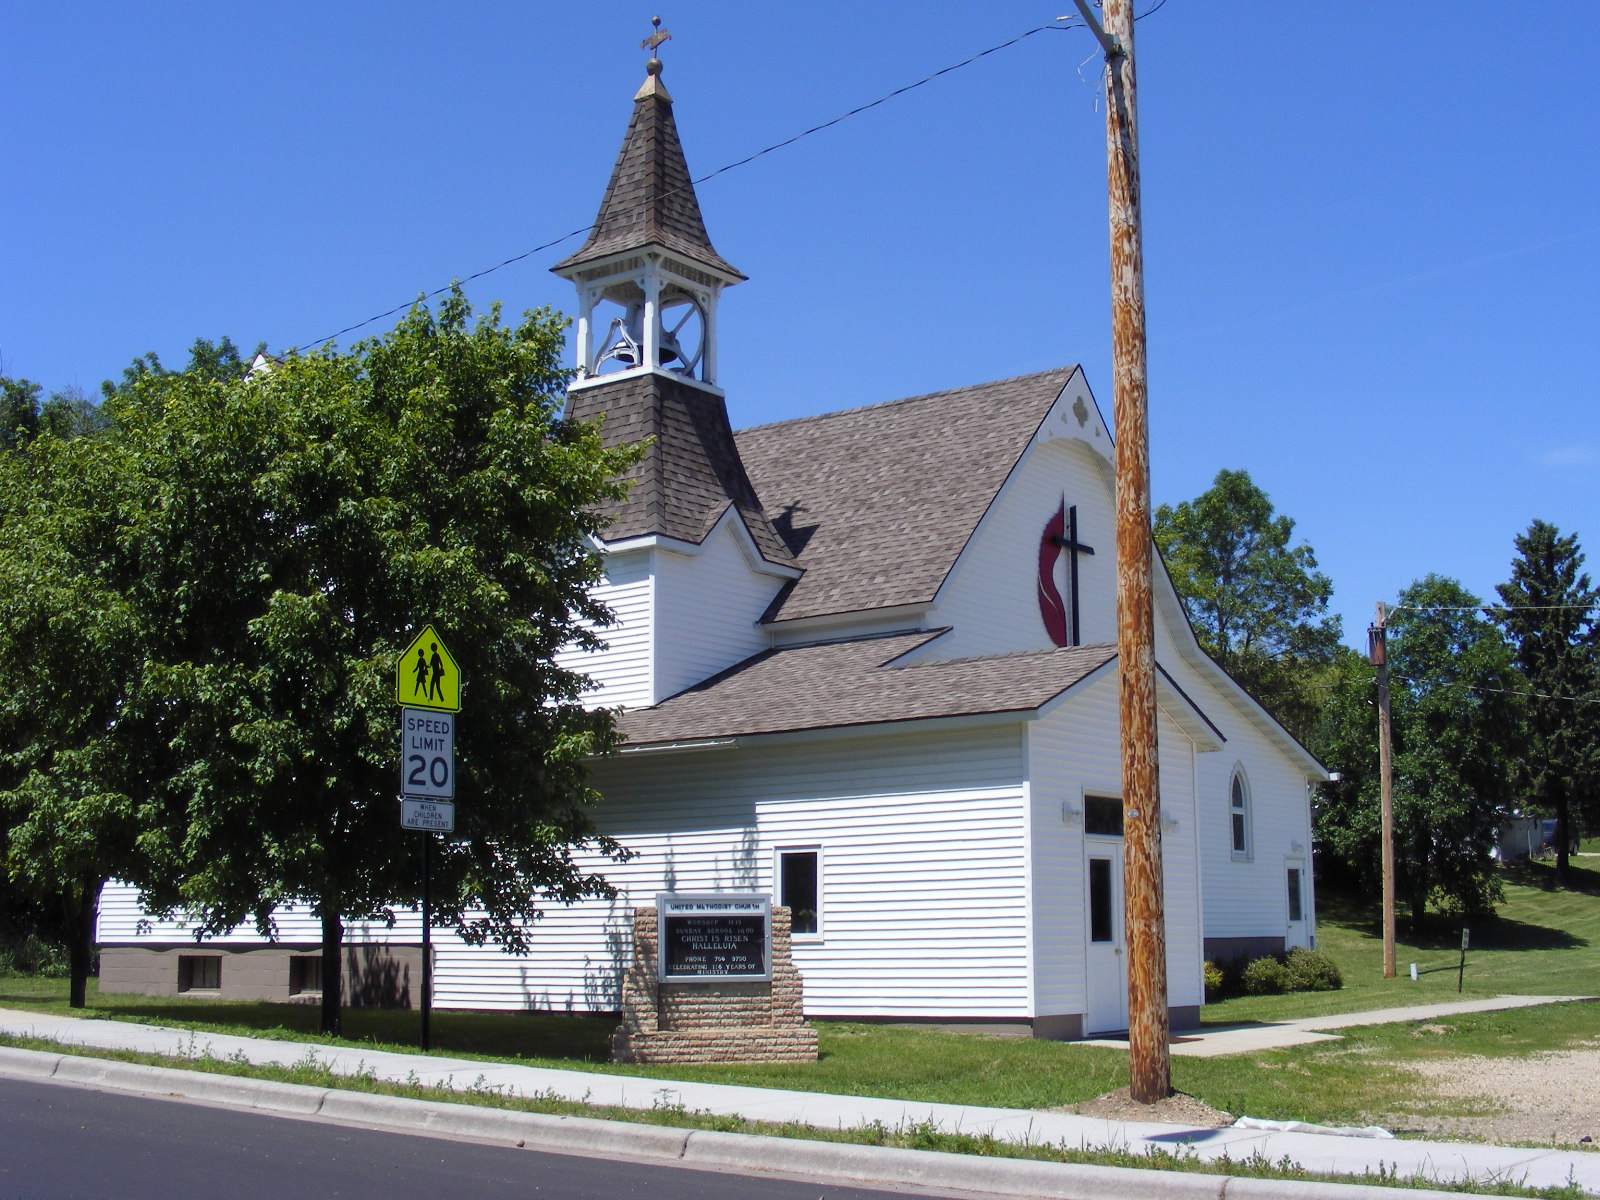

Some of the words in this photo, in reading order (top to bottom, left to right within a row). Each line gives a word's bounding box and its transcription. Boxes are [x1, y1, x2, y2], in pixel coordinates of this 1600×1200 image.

[408, 718, 450, 734] SPEED
[412, 736, 445, 751] LIMIT
[408, 755, 449, 787] 20
[414, 811, 442, 819] CHILDREN
[423, 820, 449, 828] PRESENT
